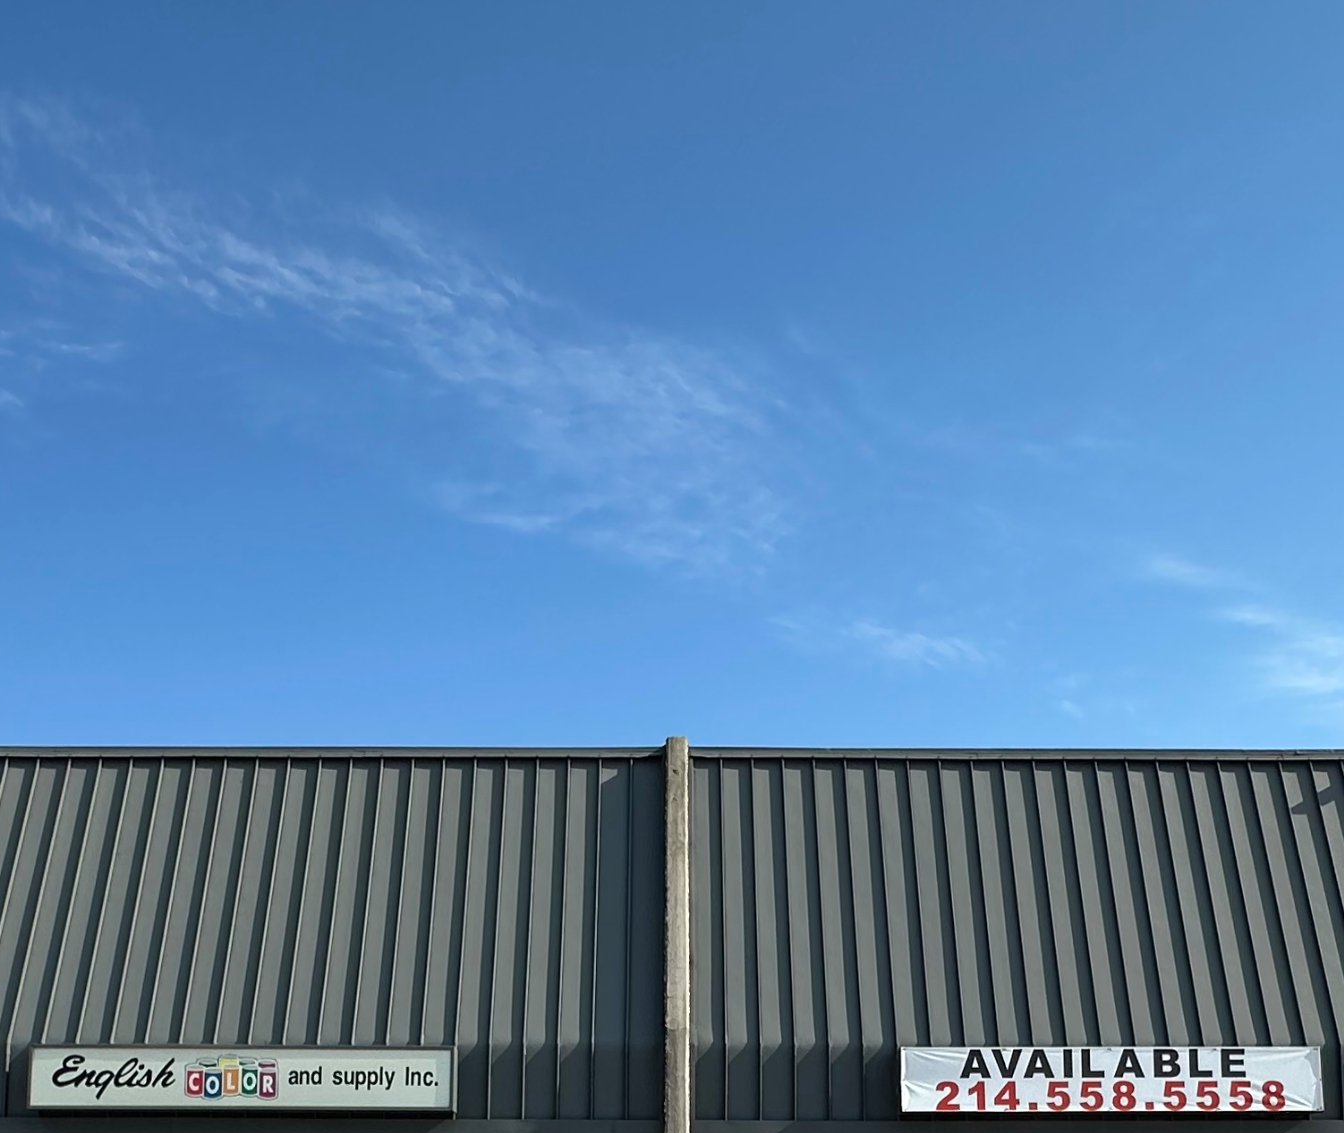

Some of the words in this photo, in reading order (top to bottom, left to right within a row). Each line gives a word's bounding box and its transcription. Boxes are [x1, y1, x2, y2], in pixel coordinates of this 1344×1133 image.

[52, 1054, 176, 1100] English
[188, 1072, 274, 1095] COLOR
[288, 1066, 322, 1085] and
[332, 1066, 396, 1090] supply
[405, 1066, 439, 1086] Inc.
[960, 1048, 1247, 1078] AVAILABLE
[935, 1080, 1287, 1111] 214.558.5558
